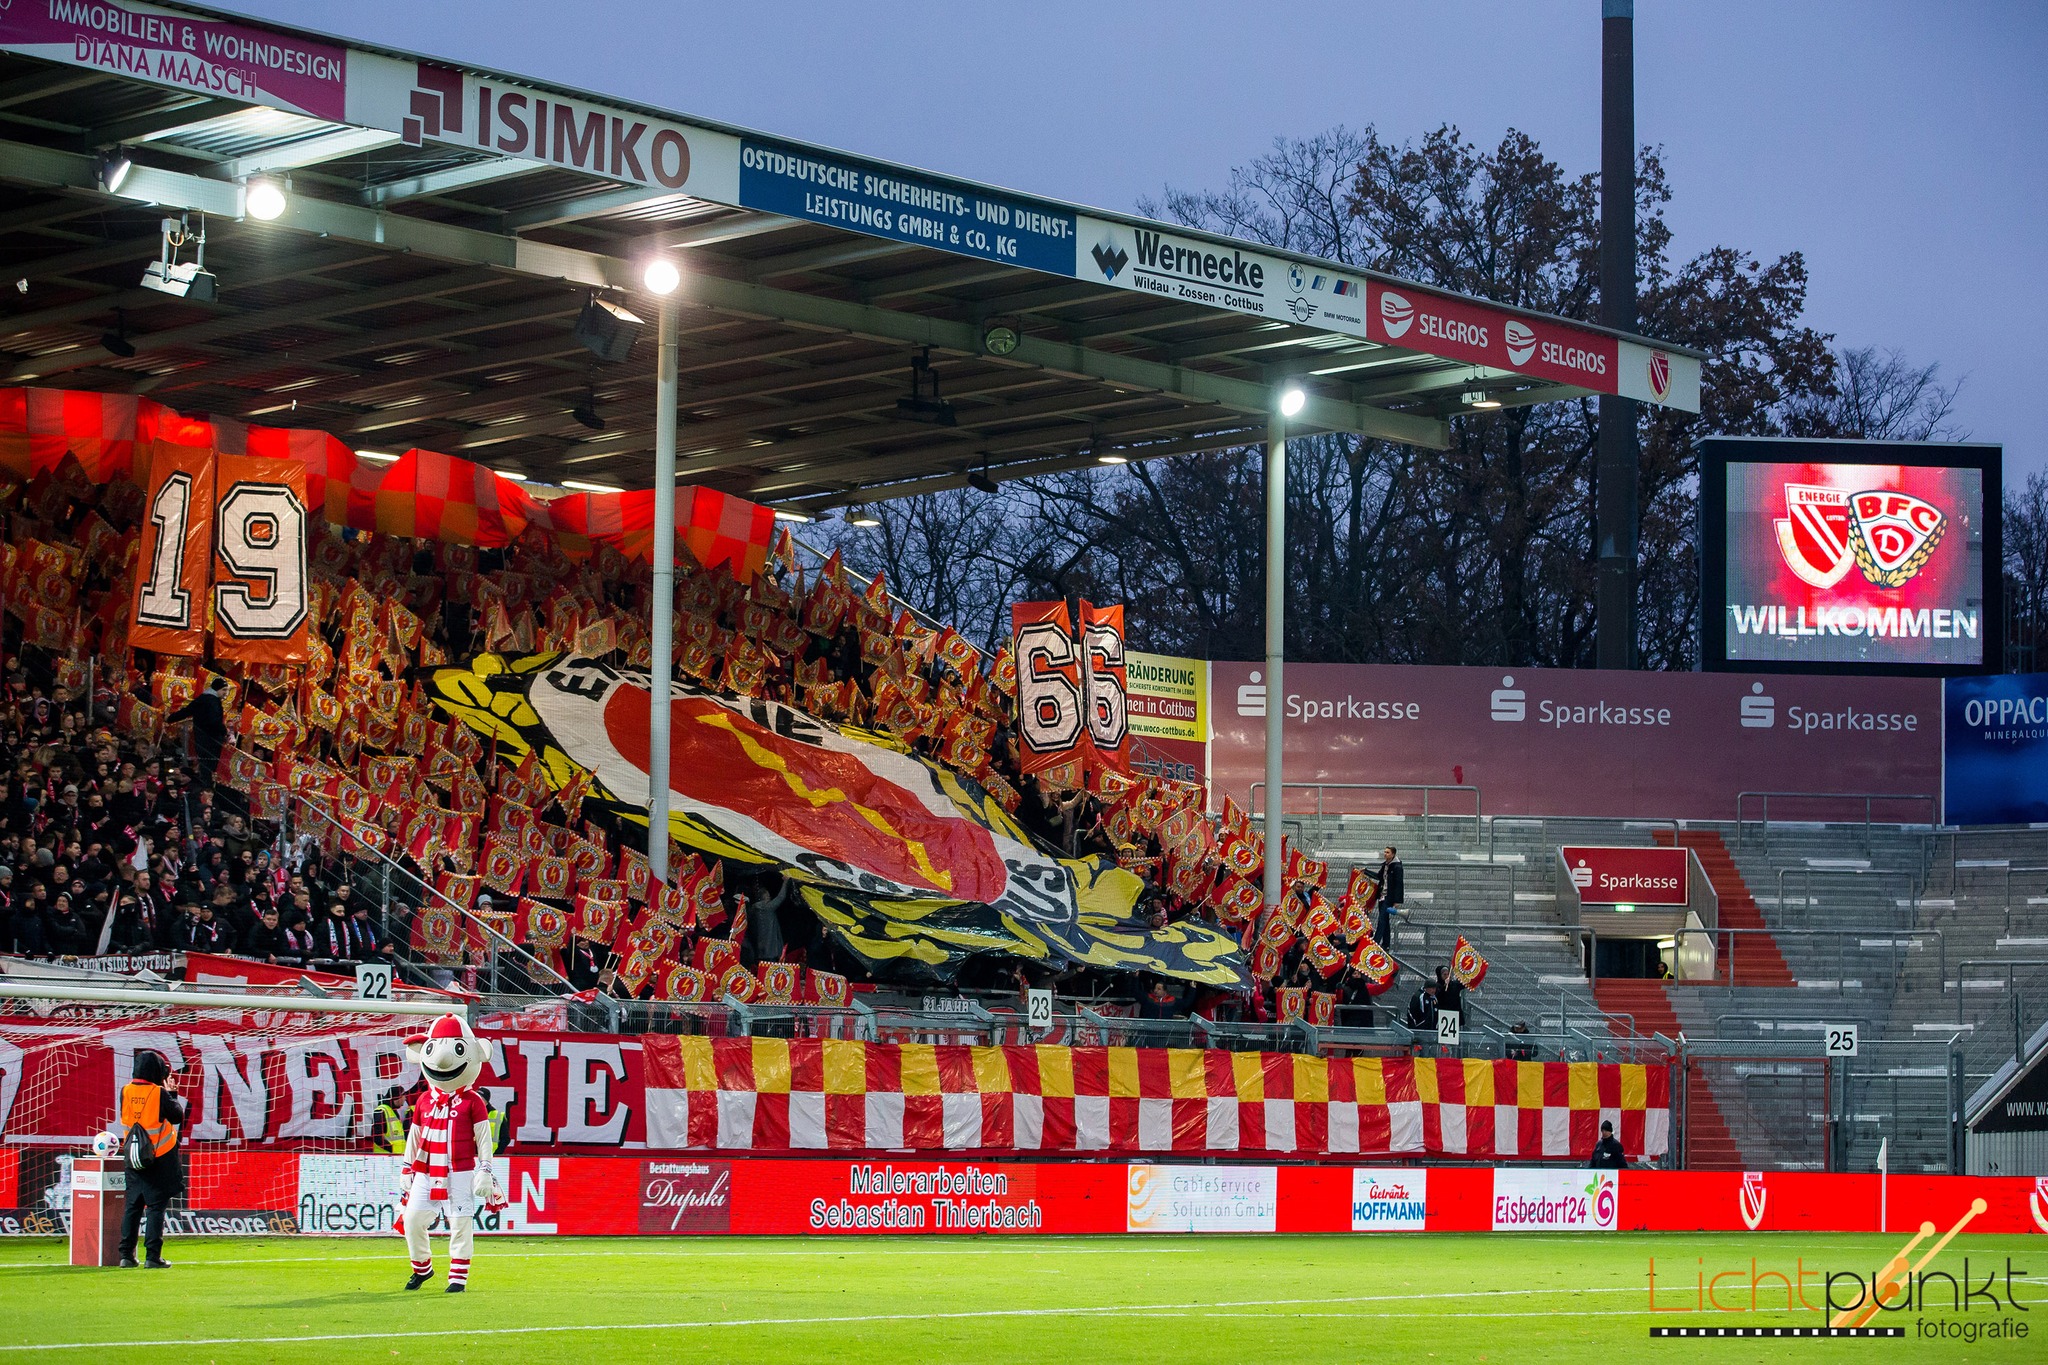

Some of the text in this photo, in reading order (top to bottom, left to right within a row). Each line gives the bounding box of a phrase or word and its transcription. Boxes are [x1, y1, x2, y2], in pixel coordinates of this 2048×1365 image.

[50, 0, 341, 83] IMMOBILIEN & WOHNDESIGN
[75, 33, 257, 98] DIANA MAASCH
[478, 86, 691, 189] ISIMKO
[742, 147, 1074, 240] OSTDEUTSCHE SICHERHEITS- UND DIENST-
[805, 192, 1018, 258] LEISTUNGS GMBH & CO. KG
[1134, 229, 1265, 289] Wernecke
[1133, 275, 1265, 312] Wildau Zossen Cottbus
[1419, 314, 1489, 348] SELGROS
[1541, 341, 1606, 375] SELGROS
[1798, 490, 1842, 504] ENERGIE
[1857, 495, 1938, 533] BFC
[1730, 604, 1978, 639] WILLKOMMEN
[1147, 697, 1157, 714] in
[1159, 699, 1196, 719] Cottbus
[1286, 695, 1421, 723] Sparkasse
[1539, 700, 1672, 729] Sparkasse
[1787, 706, 1918, 734] Sparkasse
[1964, 696, 2048, 727] OPPAC
[1984, 729, 2048, 740] MINERALQU
[1599, 873, 1678, 891] Sparkasse
[131, 954, 172, 971] COTTBUS
[361, 971, 388, 999] 22
[1031, 996, 1050, 1020] 23
[1440, 1015, 1457, 1038] 24
[1829, 1031, 1854, 1051] 25
[131, 1096, 146, 1105] FOTO
[2006, 1101, 2048, 1117] www.w
[649, 1161, 710, 1177] Bestattungshaus
[849, 1164, 1008, 1195] Malerarbeiten
[642, 1170, 730, 1231] Dupski
[1369, 1184, 1410, 1200] Getränke
[299, 1192, 396, 1231] fliesen
[810, 1198, 1042, 1229] Sebastian Thierbach
[1173, 1201, 1275, 1217] Solution GmbH
[1353, 1201, 1426, 1221] HOFFMANN
[1495, 1195, 1587, 1224] Eisbedarf24
